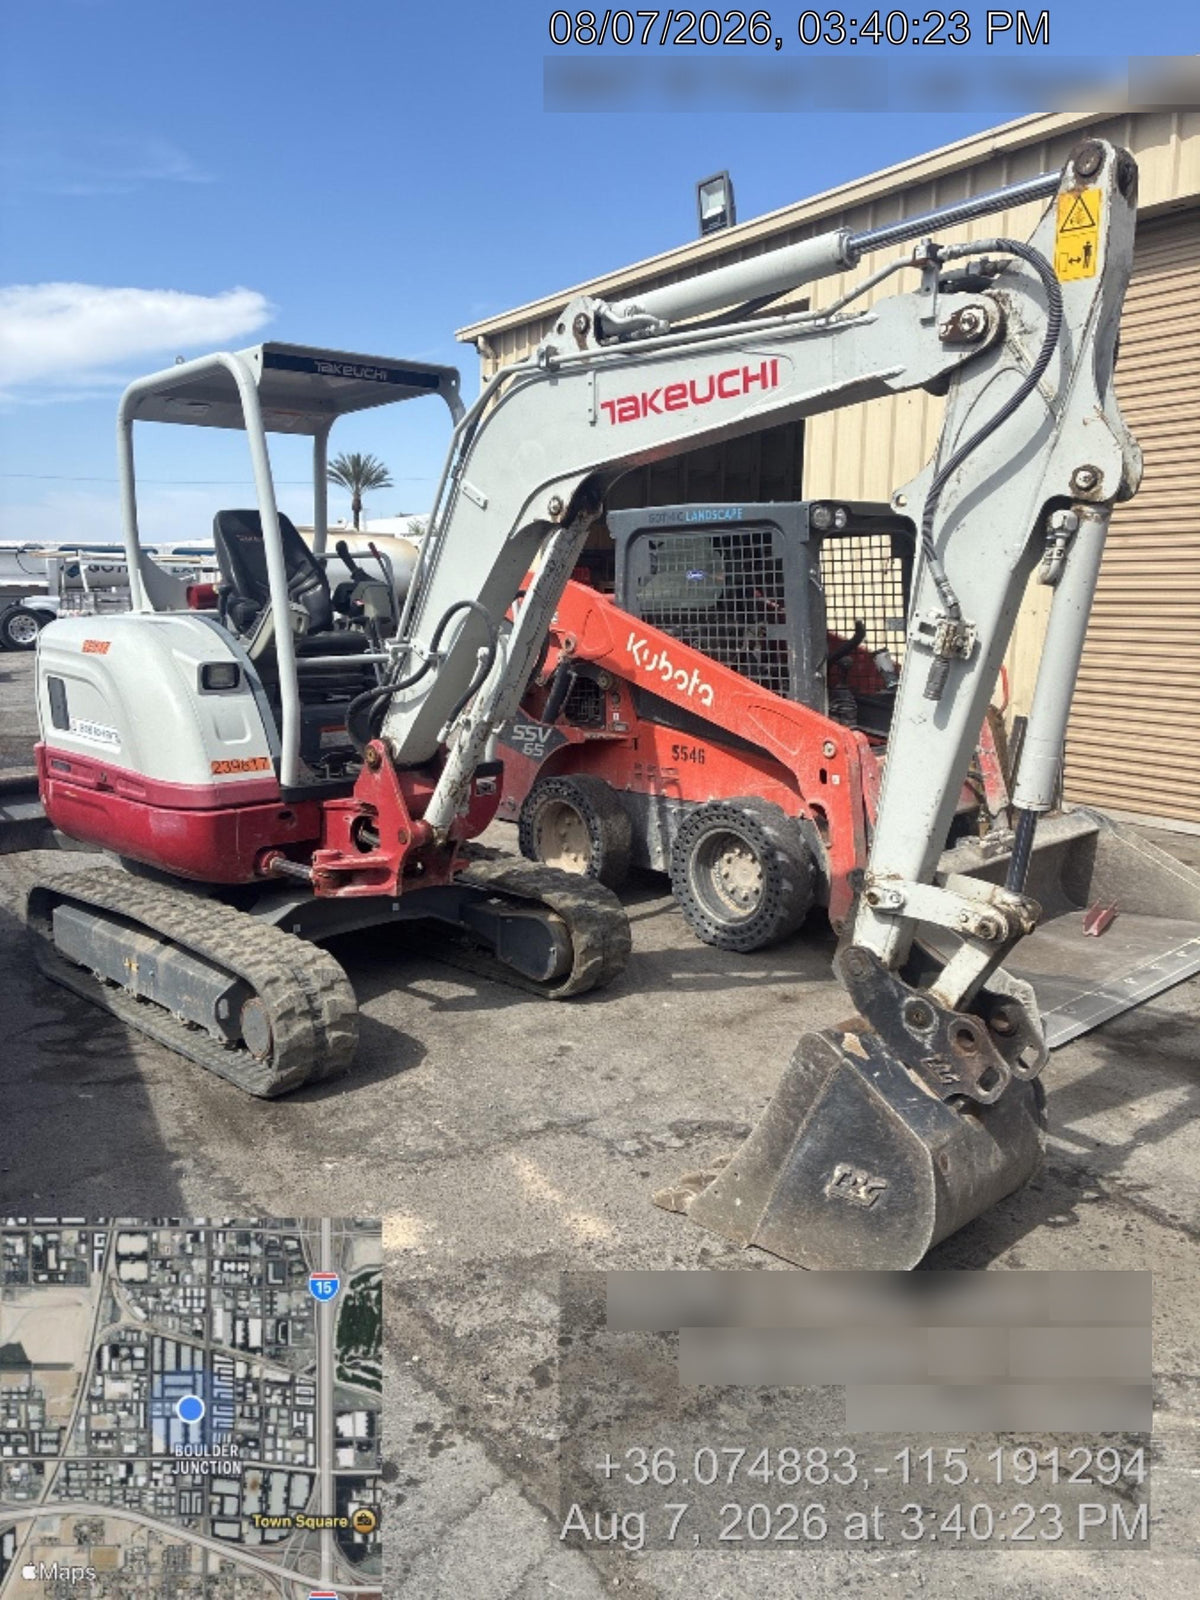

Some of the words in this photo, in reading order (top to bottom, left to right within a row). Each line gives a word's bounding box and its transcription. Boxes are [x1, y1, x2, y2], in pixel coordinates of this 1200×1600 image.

[685, 507, 743, 521] LANDSCAPE
[626, 632, 714, 706] Kubota
[512, 725, 552, 743] SSV
[522, 743, 545, 757] 65
[672, 744, 705, 764] 5546
